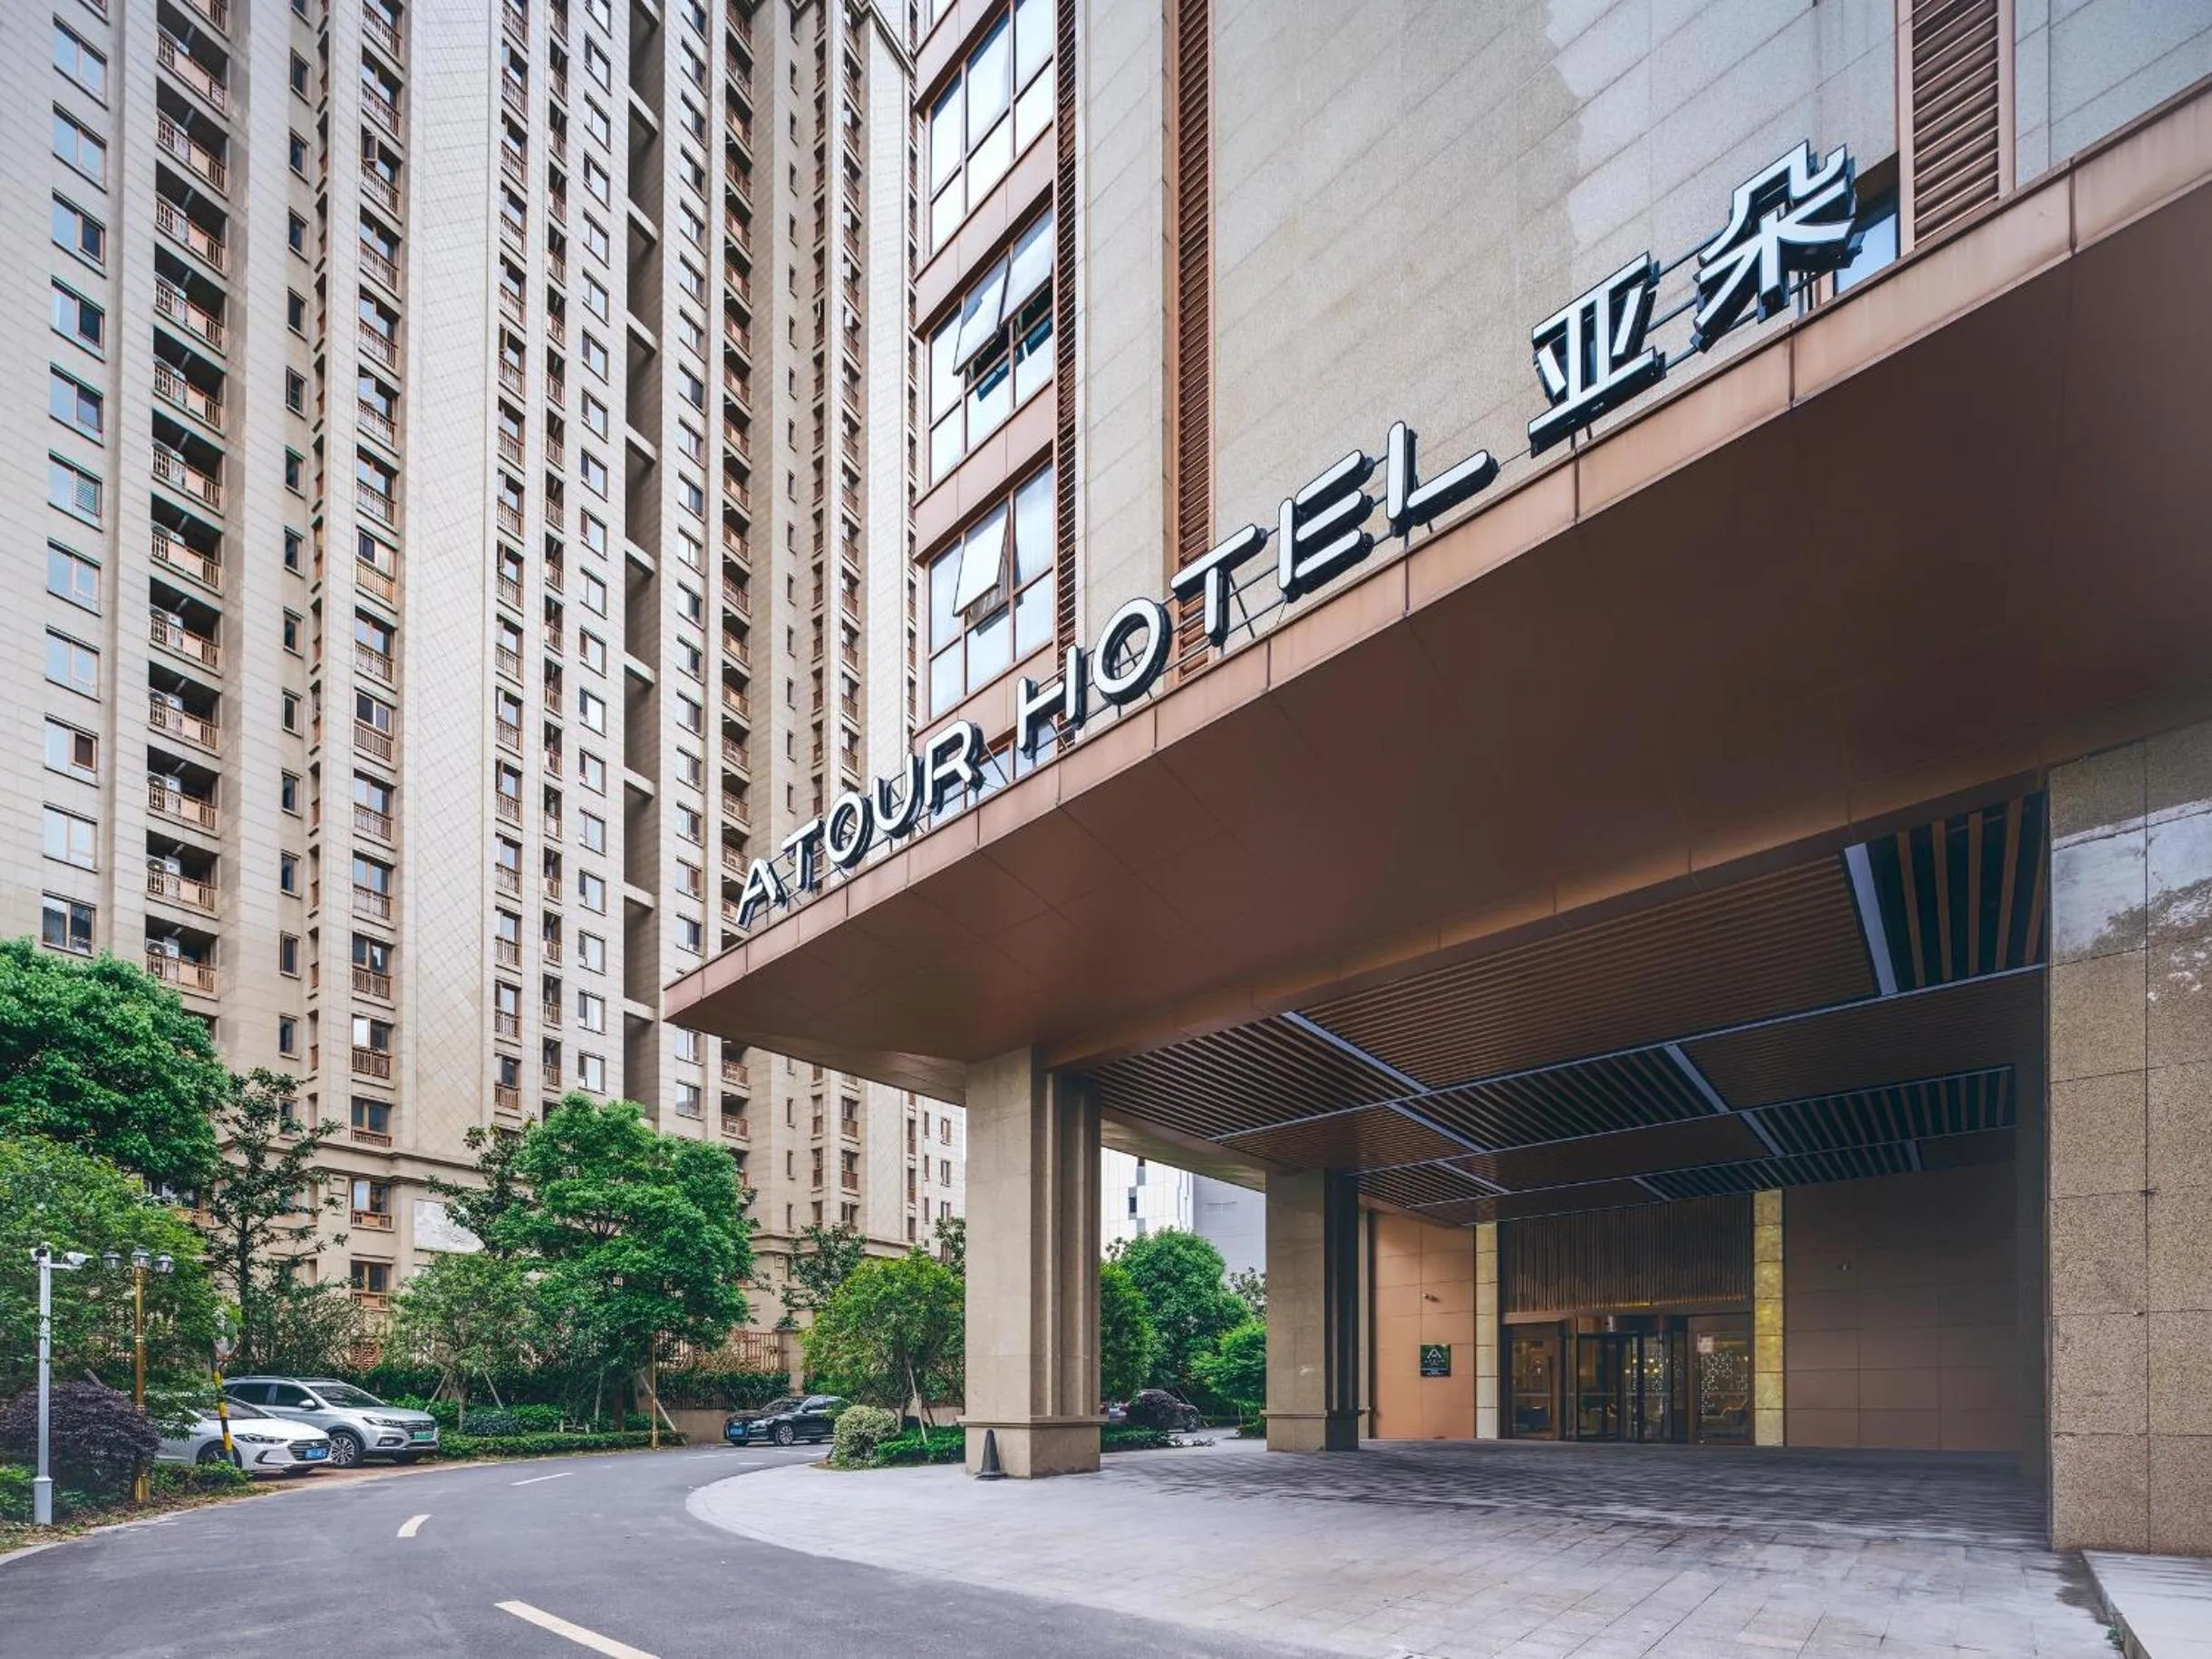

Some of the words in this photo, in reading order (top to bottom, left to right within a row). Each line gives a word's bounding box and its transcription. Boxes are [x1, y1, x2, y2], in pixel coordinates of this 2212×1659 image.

[735, 719, 985, 928] ATOUR
[1016, 421, 1499, 756] HOTEL
[1528, 139, 1860, 455] 亚朵
